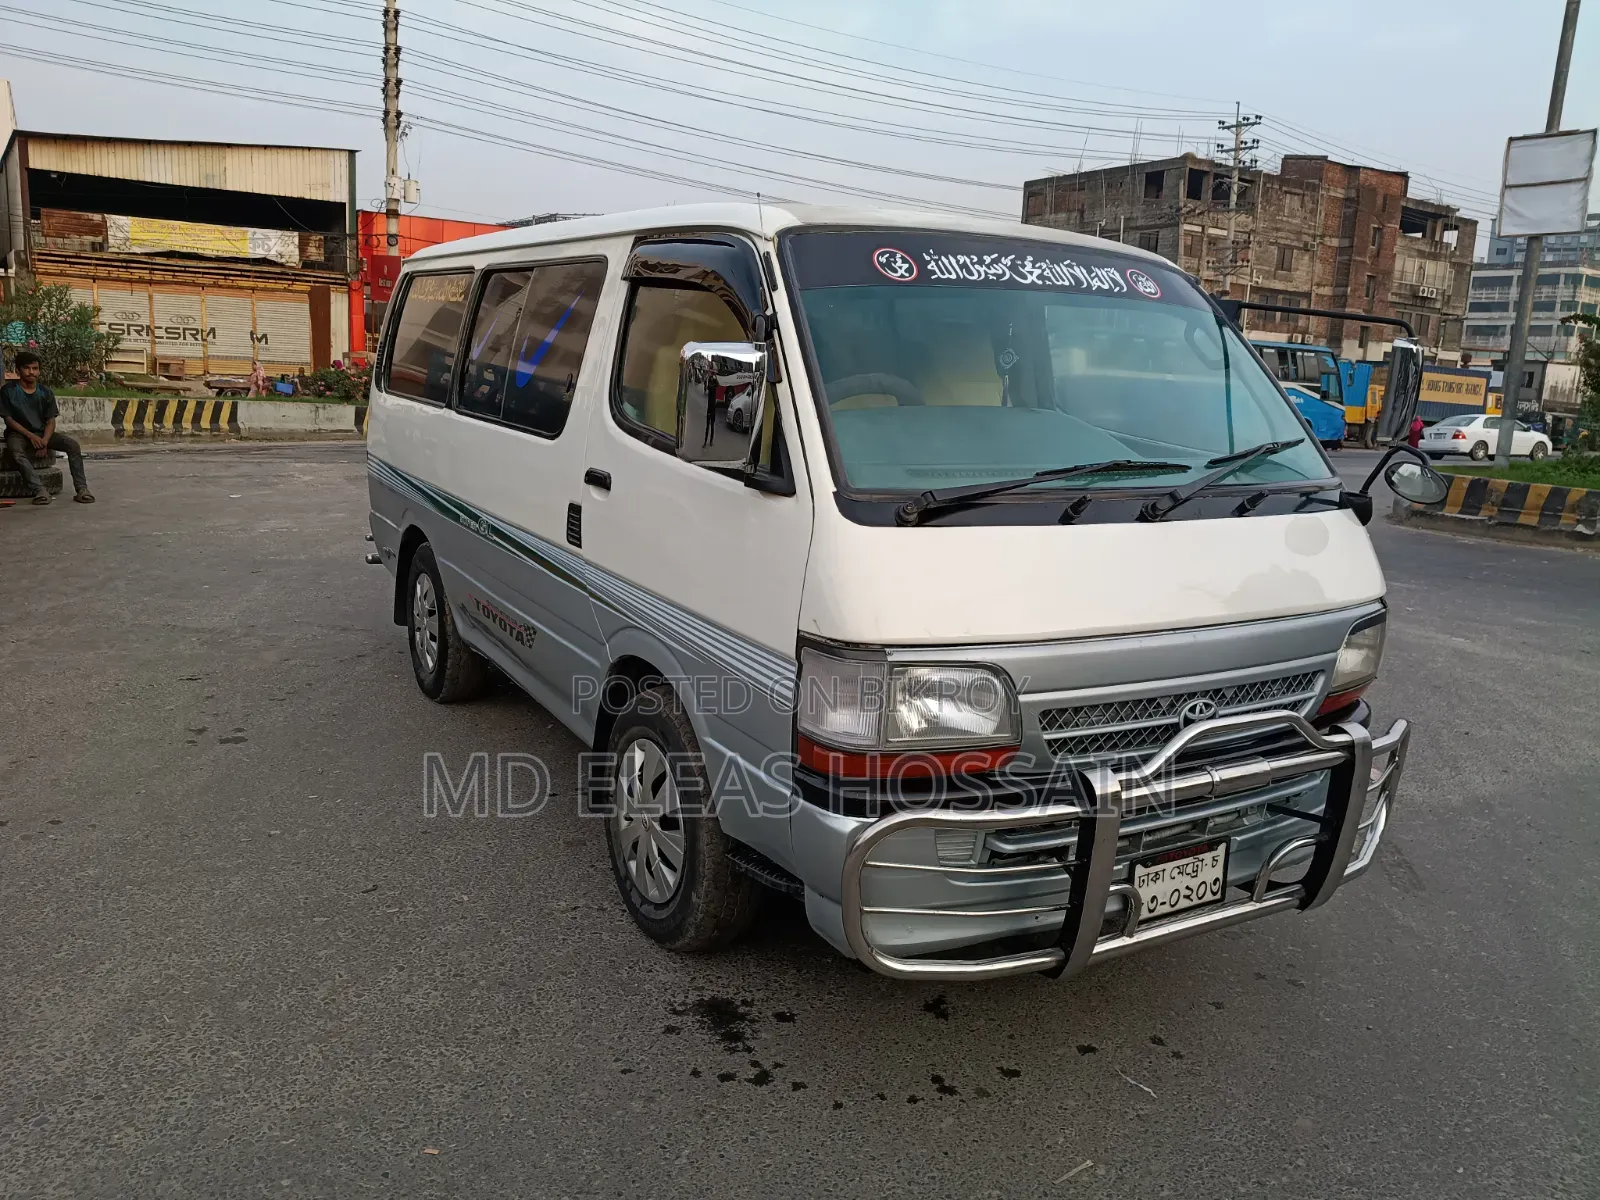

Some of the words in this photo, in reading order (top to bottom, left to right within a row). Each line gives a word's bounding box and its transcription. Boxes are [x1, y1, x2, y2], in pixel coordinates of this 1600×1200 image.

[477, 517, 496, 541] GL
[474, 597, 526, 647] TOYOTA
[1138, 868, 1167, 888] ঢাকা
